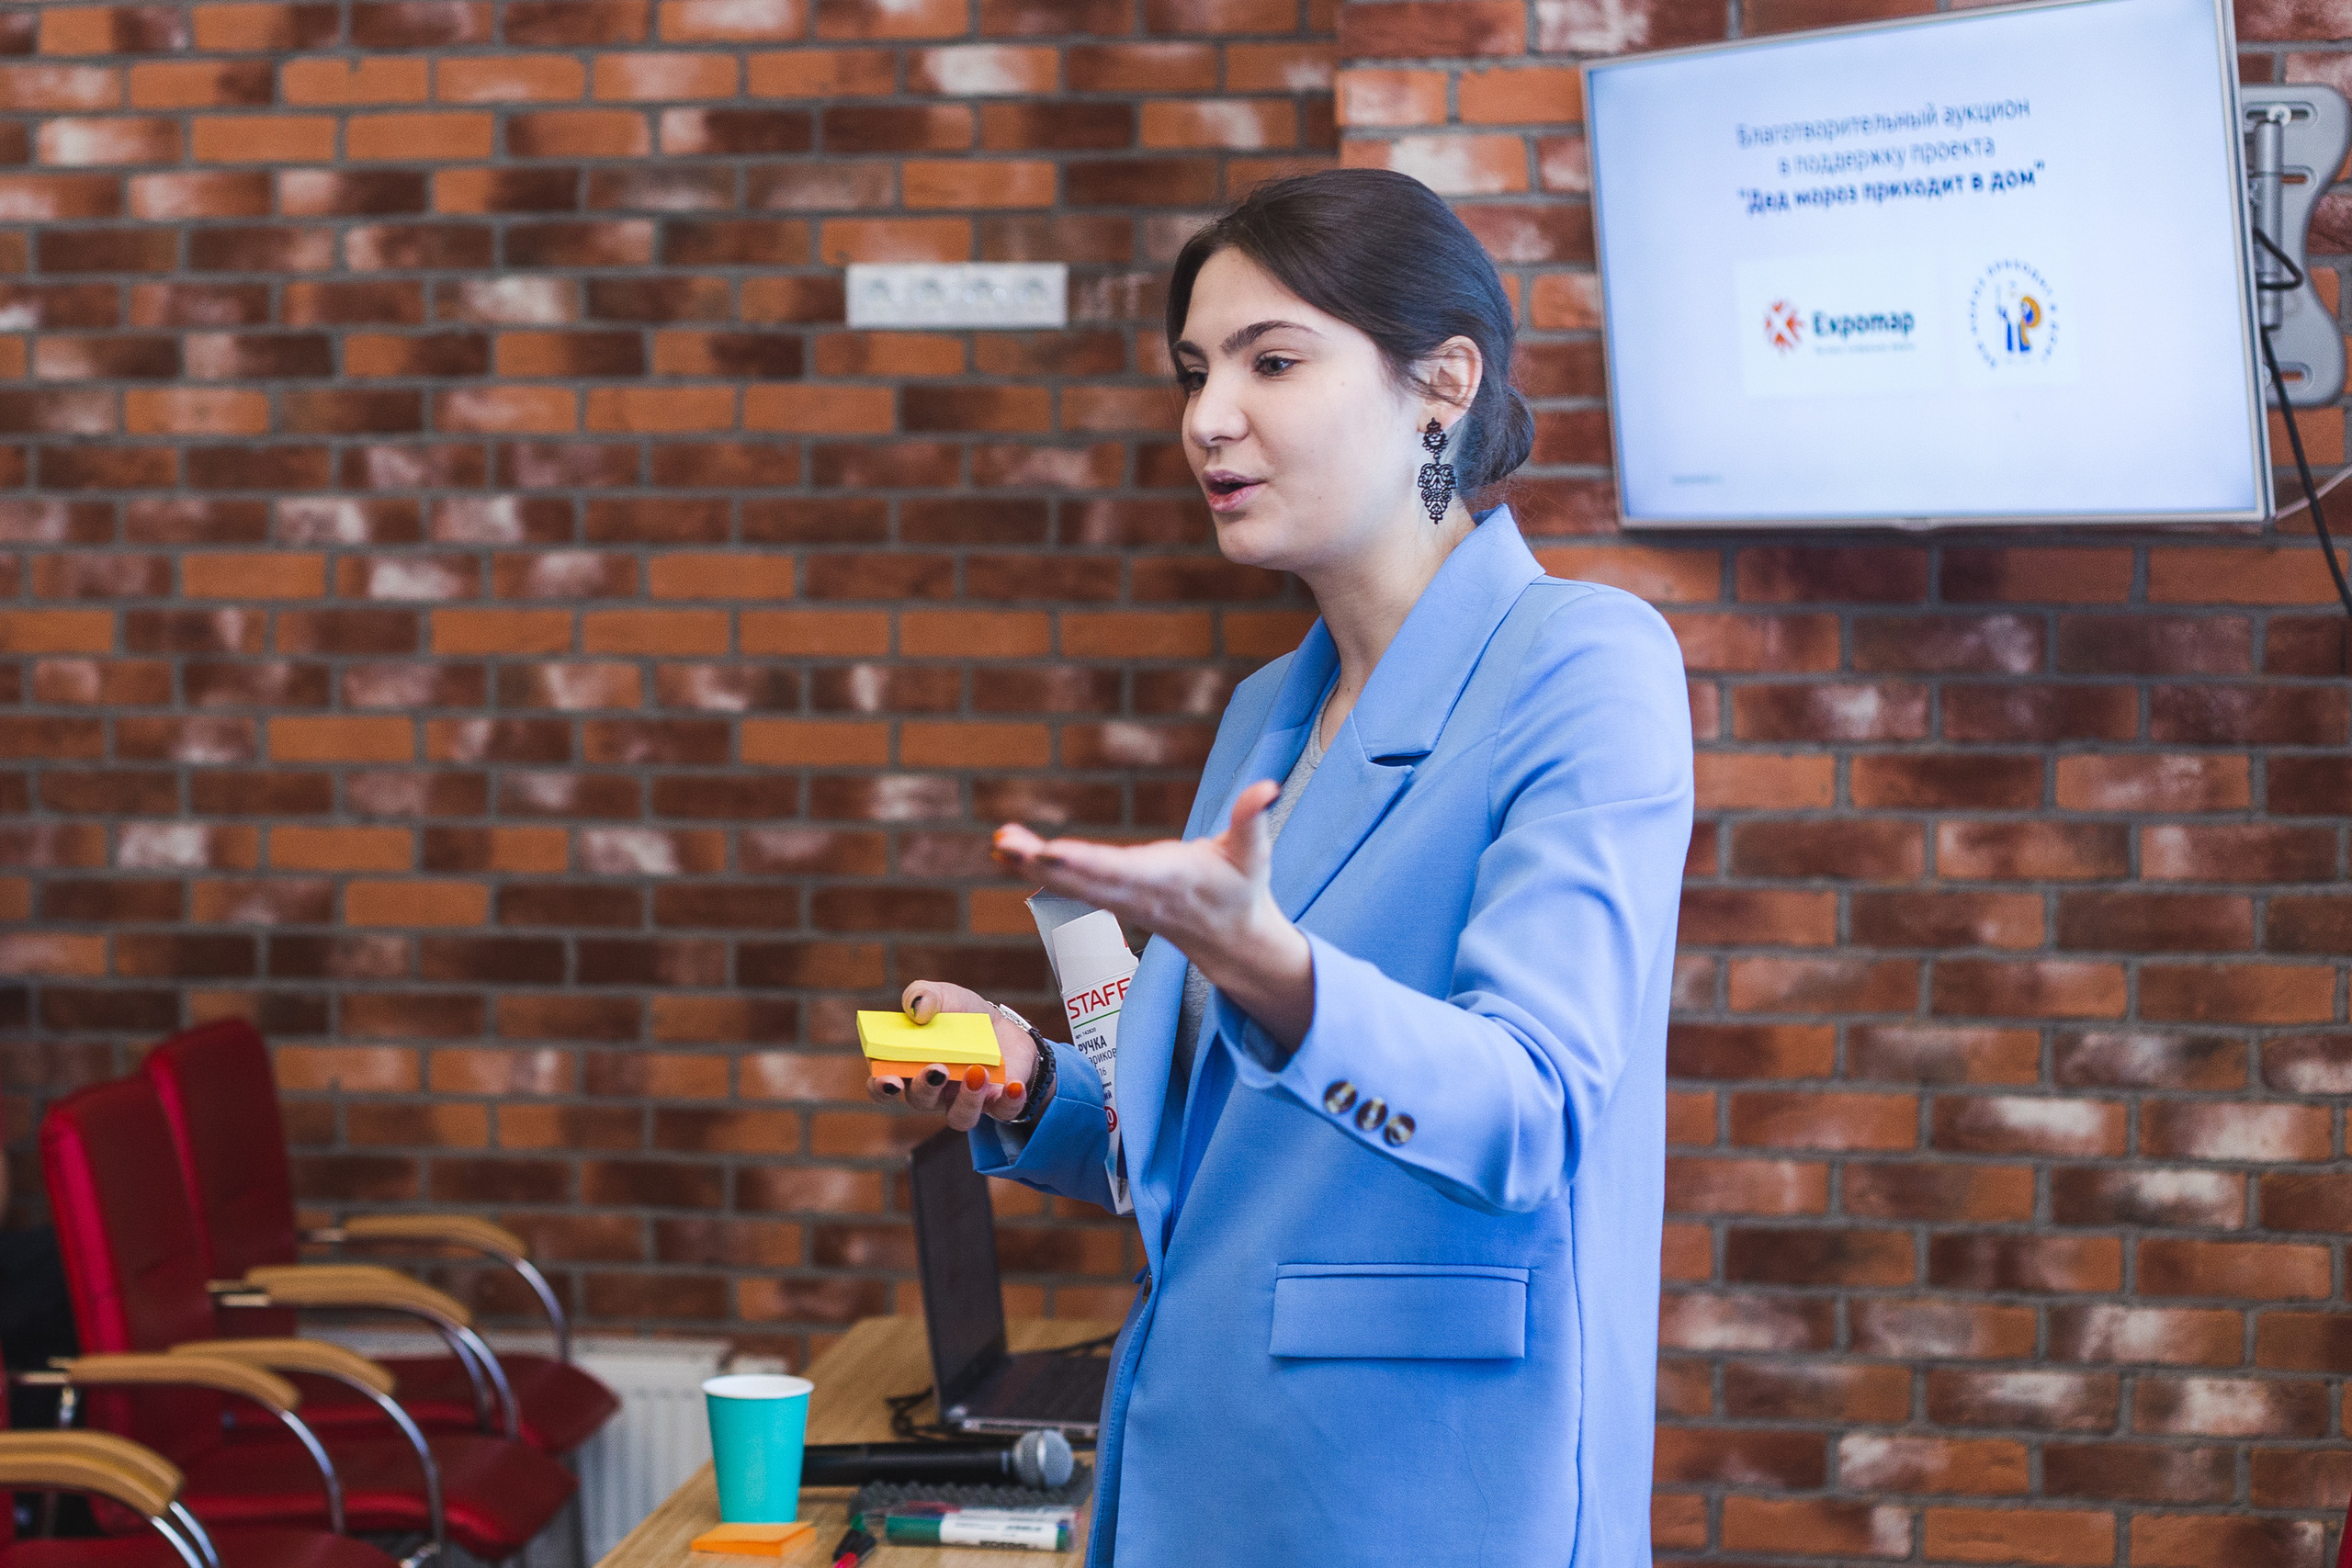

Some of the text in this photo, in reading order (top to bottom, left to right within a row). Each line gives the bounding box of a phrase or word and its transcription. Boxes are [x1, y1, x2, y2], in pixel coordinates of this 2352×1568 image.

[1736, 99, 2030, 150] Благотворительный аукцион
[1779, 137, 1995, 175] в поддержку проекта
[1794, 184, 1857, 209] мороз
[1862, 175, 1962, 204] приходит
[1971, 172, 1983, 192] в
[1814, 311, 1914, 338] Expomap
[1067, 976, 1131, 1020] STAFF
